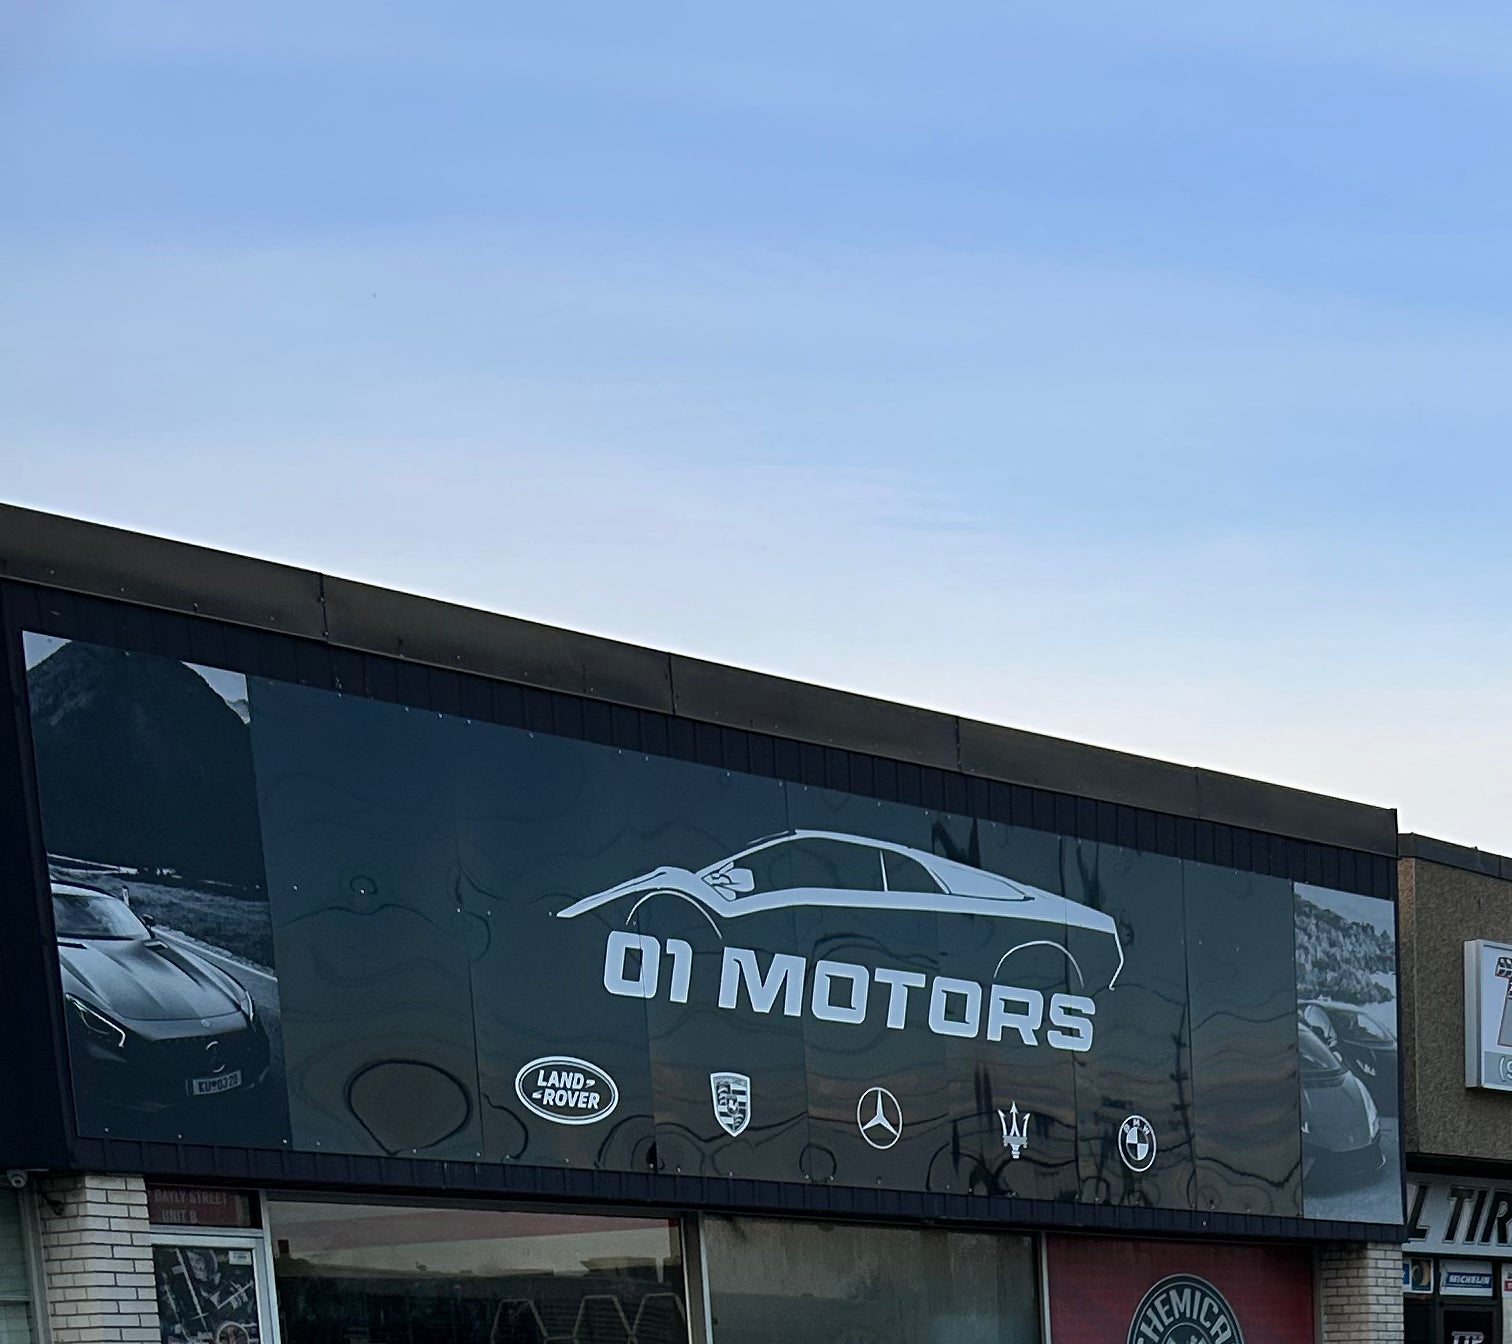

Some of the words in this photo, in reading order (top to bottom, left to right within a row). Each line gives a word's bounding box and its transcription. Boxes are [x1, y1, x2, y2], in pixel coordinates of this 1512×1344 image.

[718, 946, 1097, 1052] MOTORS
[537, 1069, 585, 1090] LAND
[543, 1088, 600, 1109] ROVER
[1448, 1274, 1491, 1285] MICHELIN
